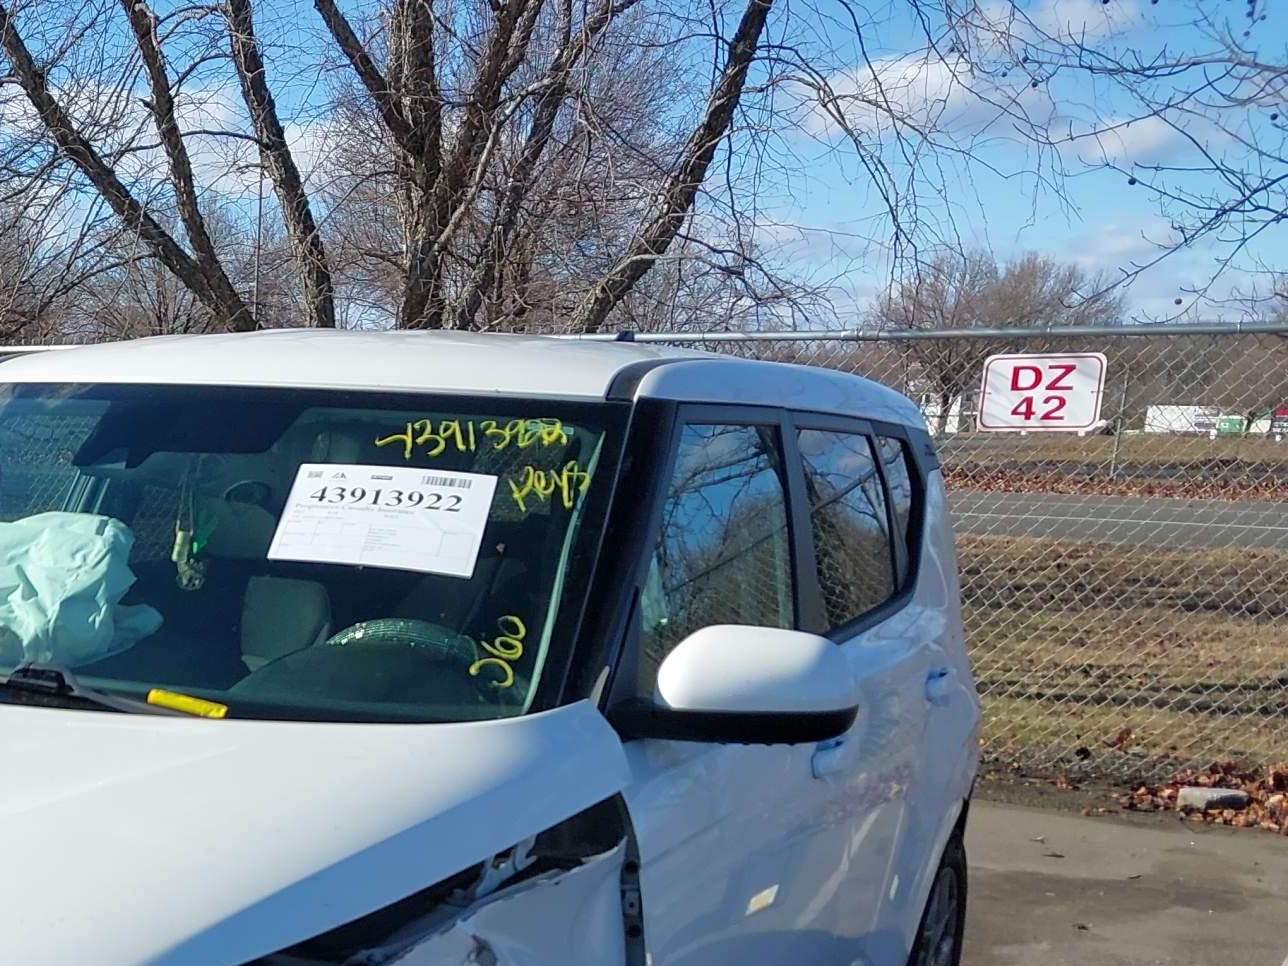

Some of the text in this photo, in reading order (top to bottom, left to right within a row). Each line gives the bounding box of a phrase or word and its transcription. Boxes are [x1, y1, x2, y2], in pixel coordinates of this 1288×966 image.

[1010, 364, 1077, 391] DZ
[1010, 395, 1067, 421] 42
[310, 485, 463, 513] 43913922
